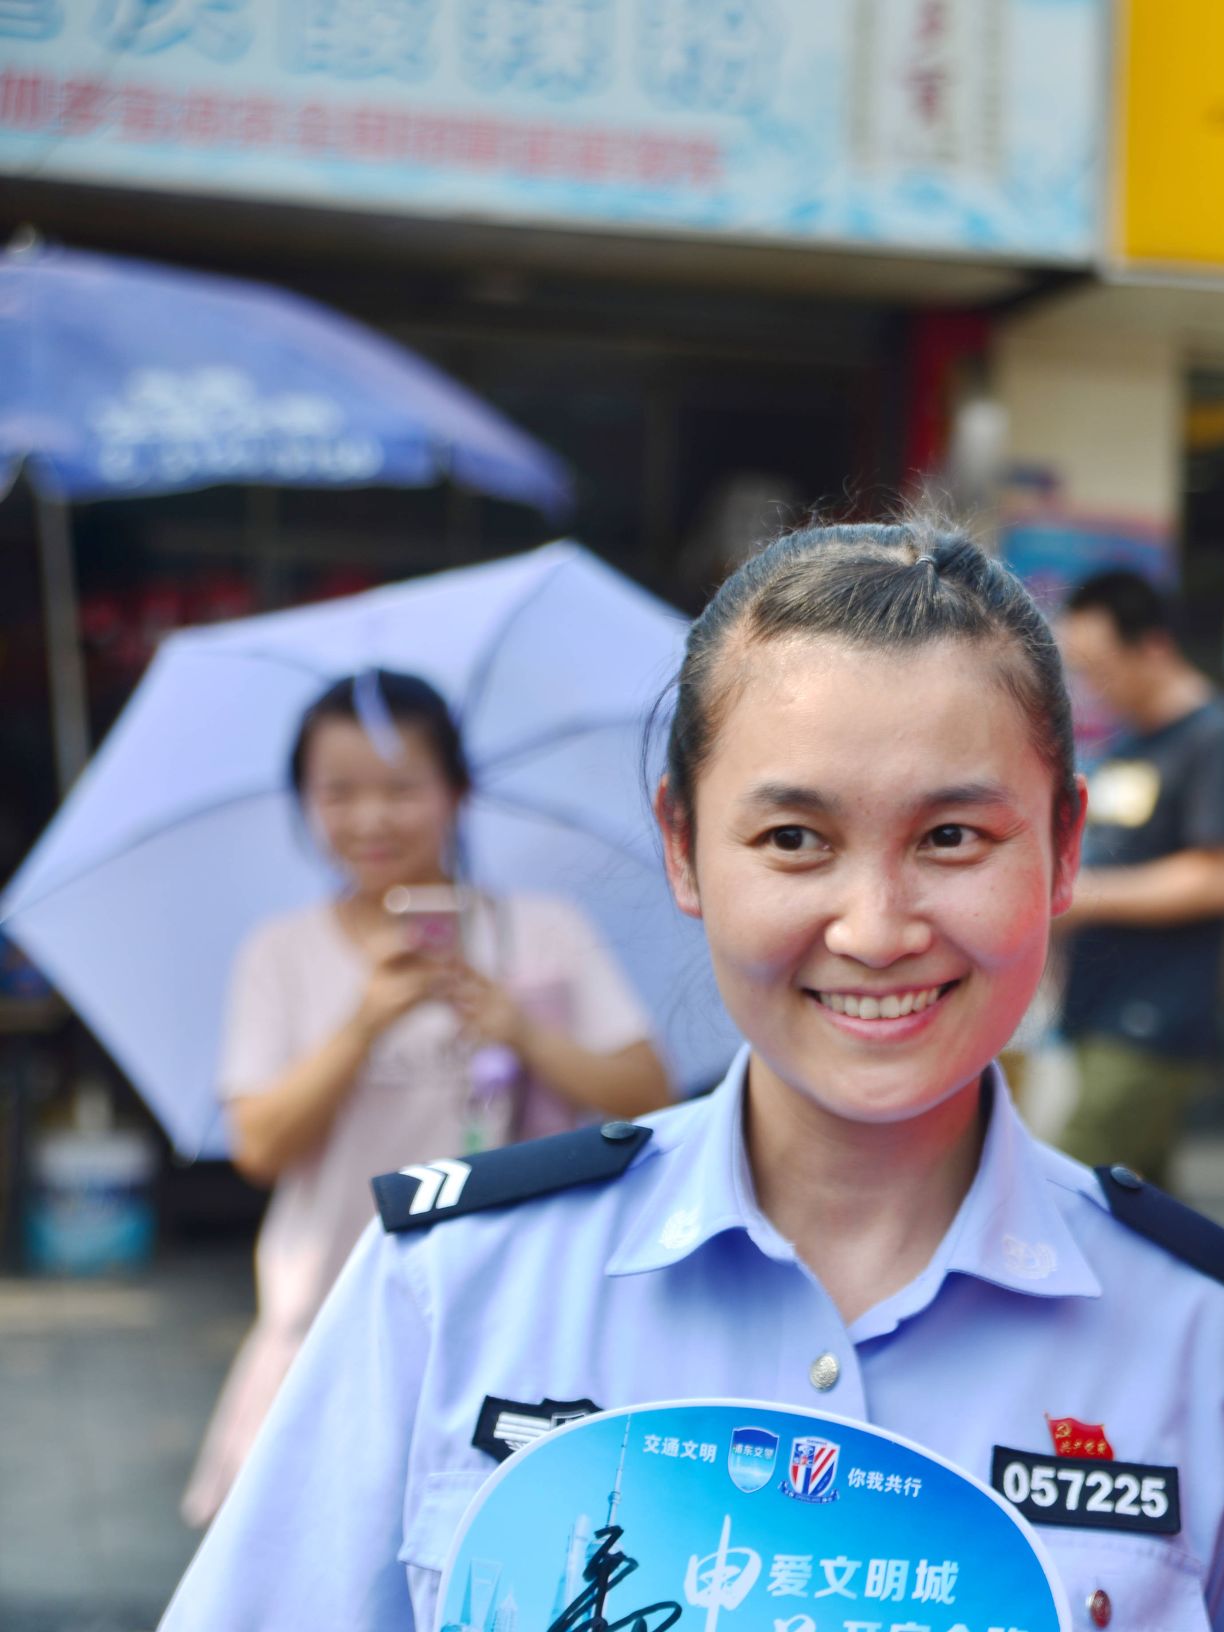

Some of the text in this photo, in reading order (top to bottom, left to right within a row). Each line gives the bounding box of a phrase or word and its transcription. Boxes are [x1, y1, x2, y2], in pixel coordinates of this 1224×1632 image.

[642, 1433, 718, 1464] 交通文明
[847, 1467, 923, 1499] 你我共行
[1003, 1460, 1169, 1518] 057225
[766, 1553, 960, 1606] 爱文明城
